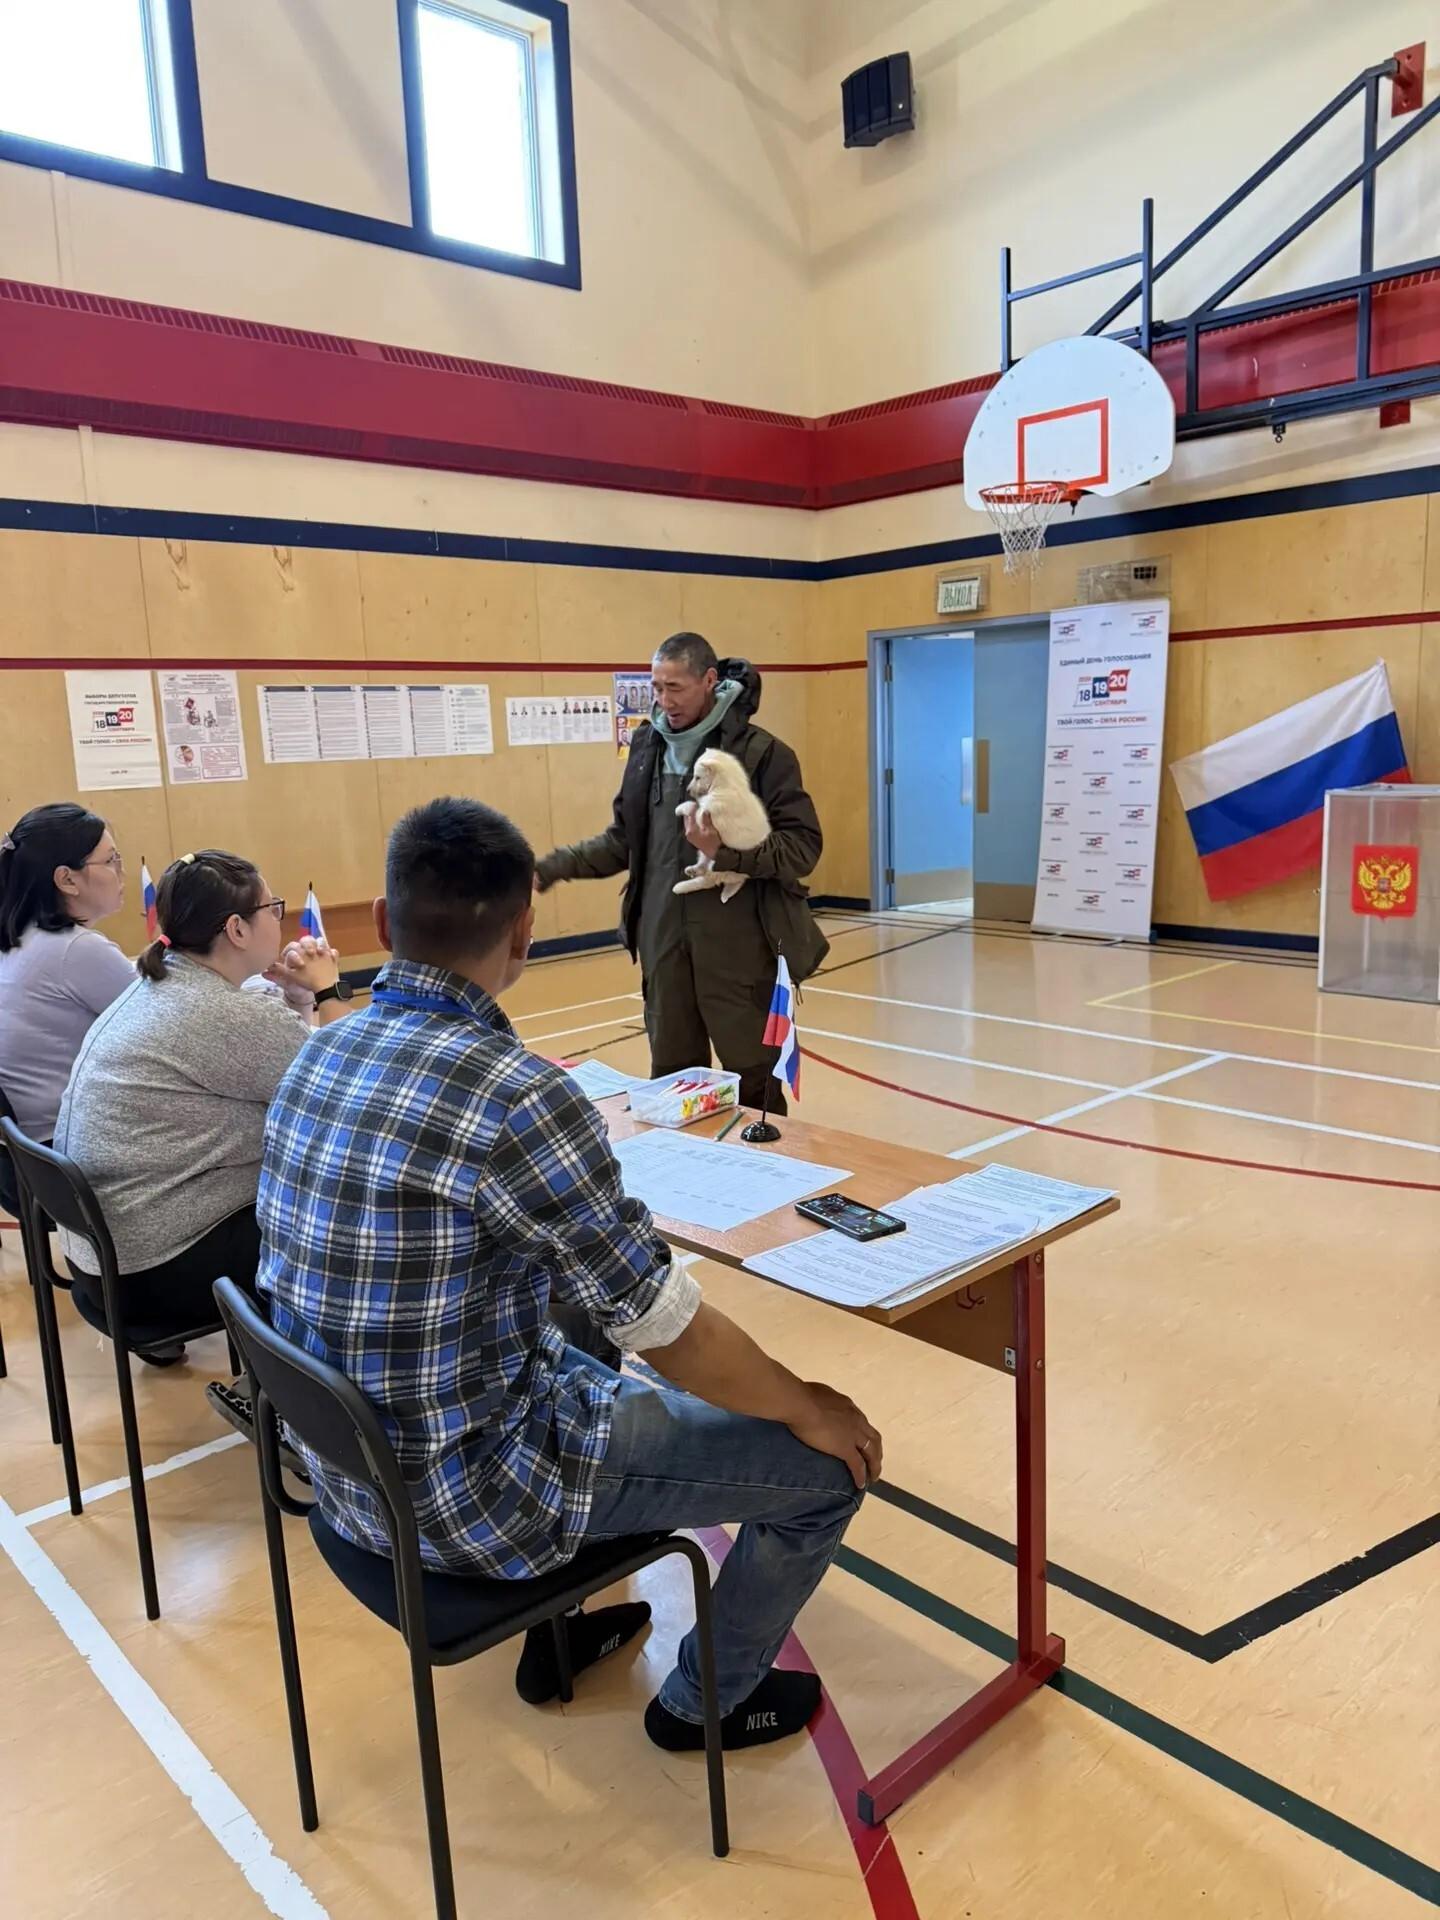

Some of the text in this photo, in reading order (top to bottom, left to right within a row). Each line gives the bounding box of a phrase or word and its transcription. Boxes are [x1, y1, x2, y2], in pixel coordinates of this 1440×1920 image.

[1079, 674, 1127, 702] 18 19 20
[95, 710, 132, 729] 18 19 20
[599, 1632, 620, 1657] NIKE
[746, 1711, 779, 1731] NIKE
